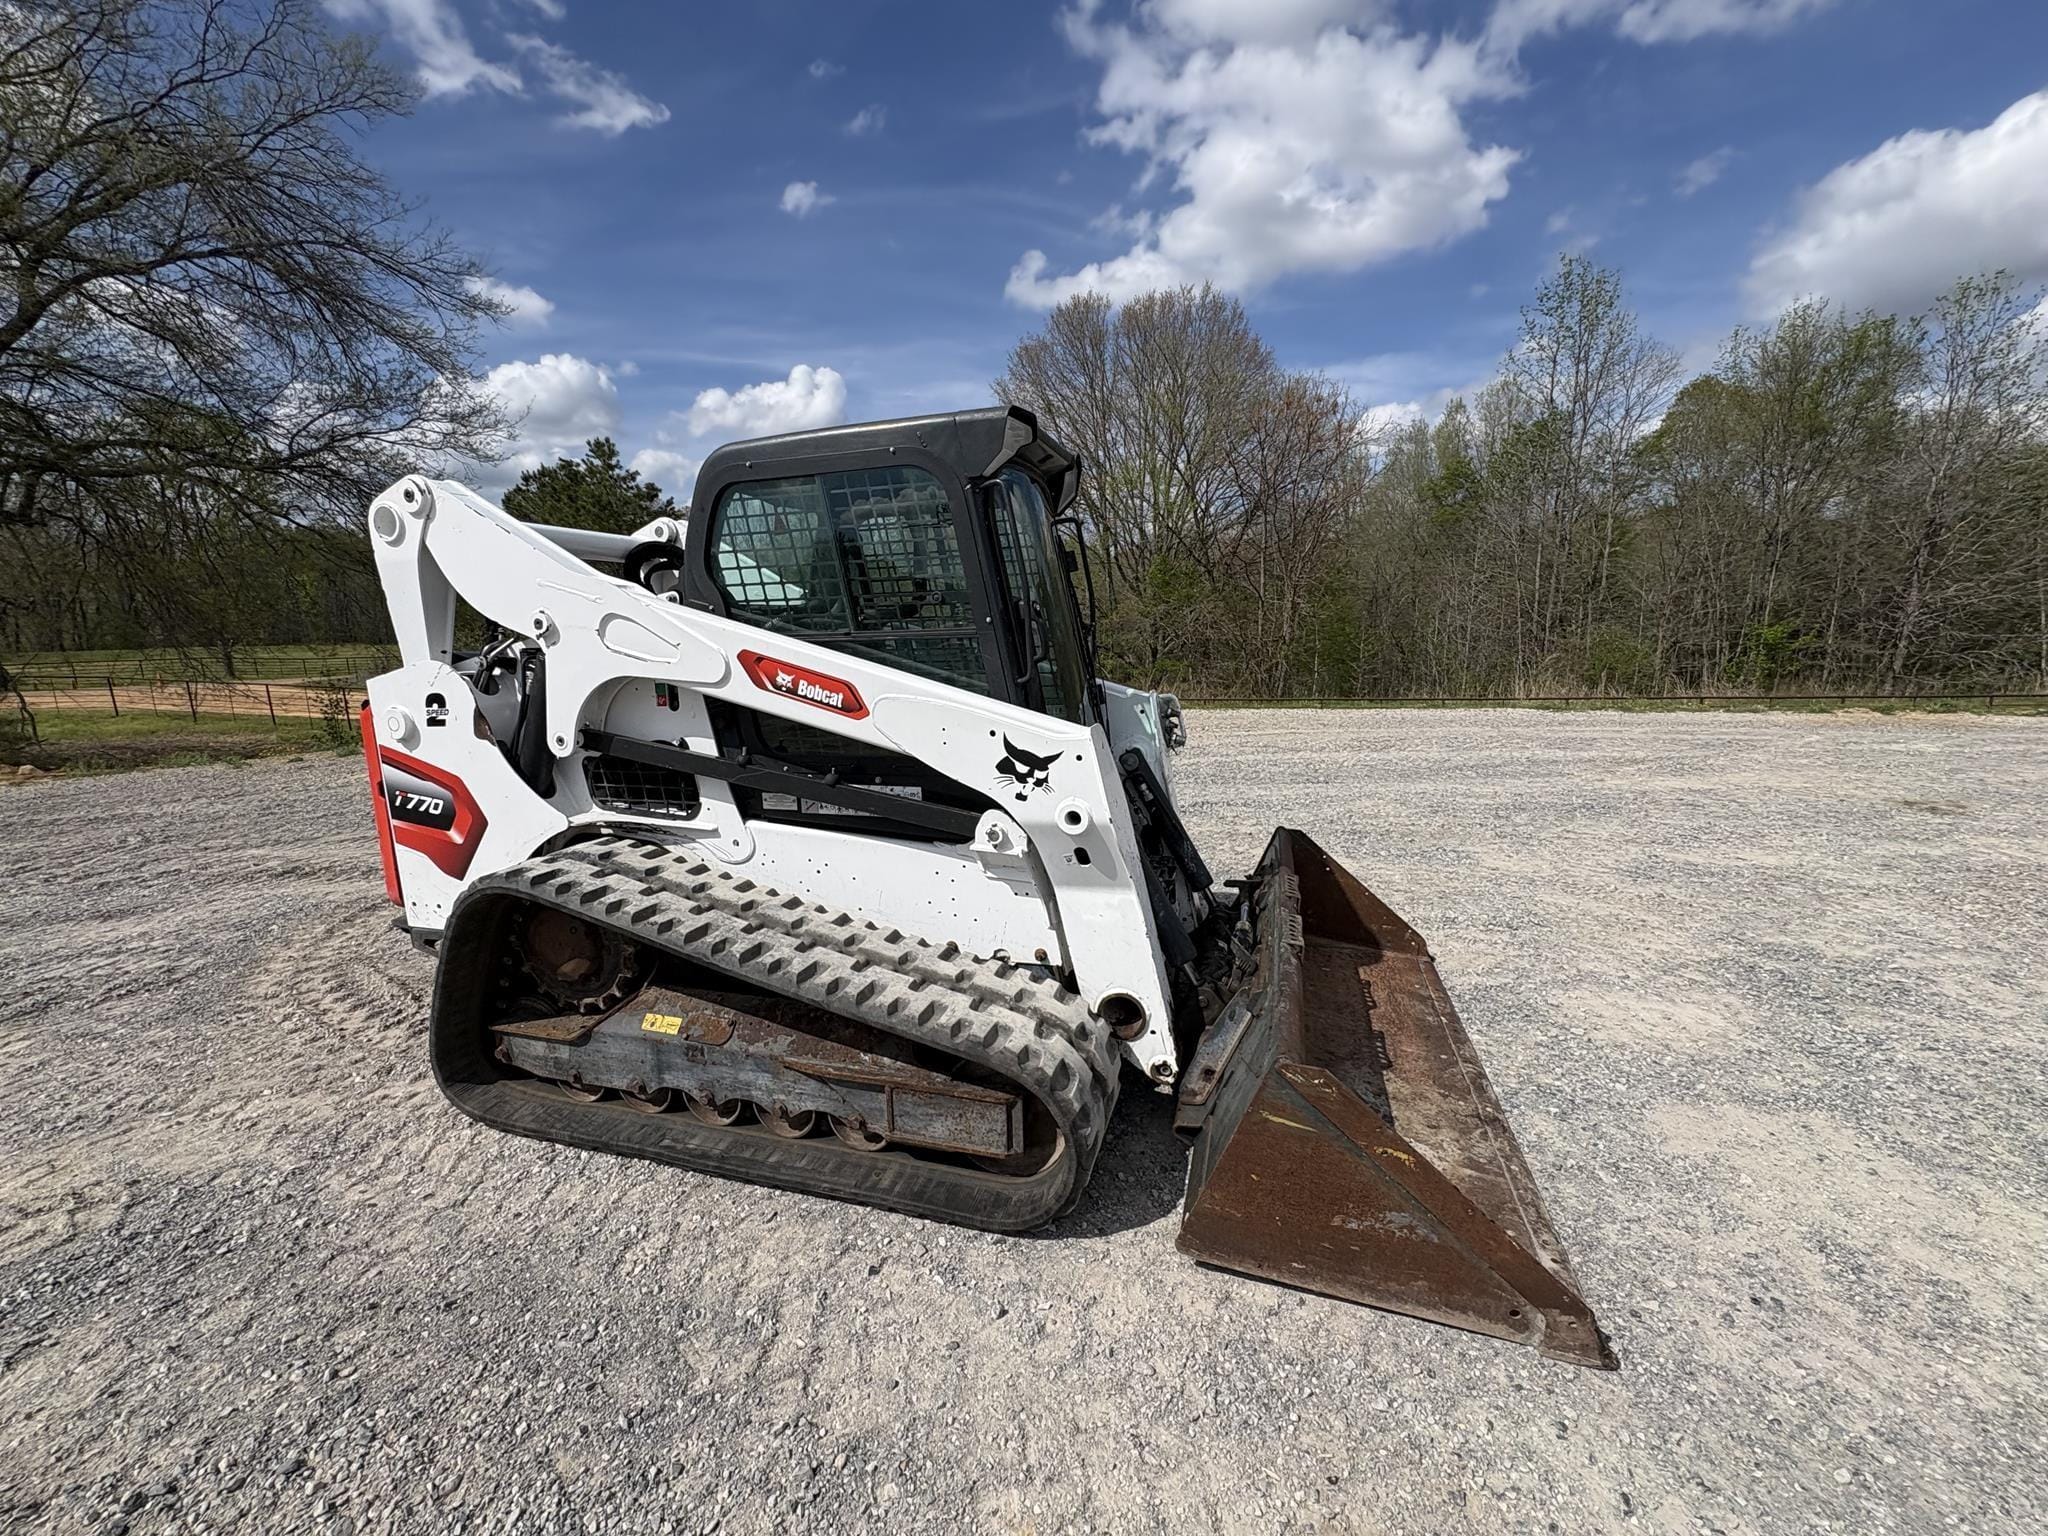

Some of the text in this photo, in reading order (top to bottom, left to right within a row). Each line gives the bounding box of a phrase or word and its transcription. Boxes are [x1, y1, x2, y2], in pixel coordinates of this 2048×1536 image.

[797, 679, 844, 708] Bobcat
[425, 692, 447, 727] 2
[426, 708, 449, 717] SPEED
